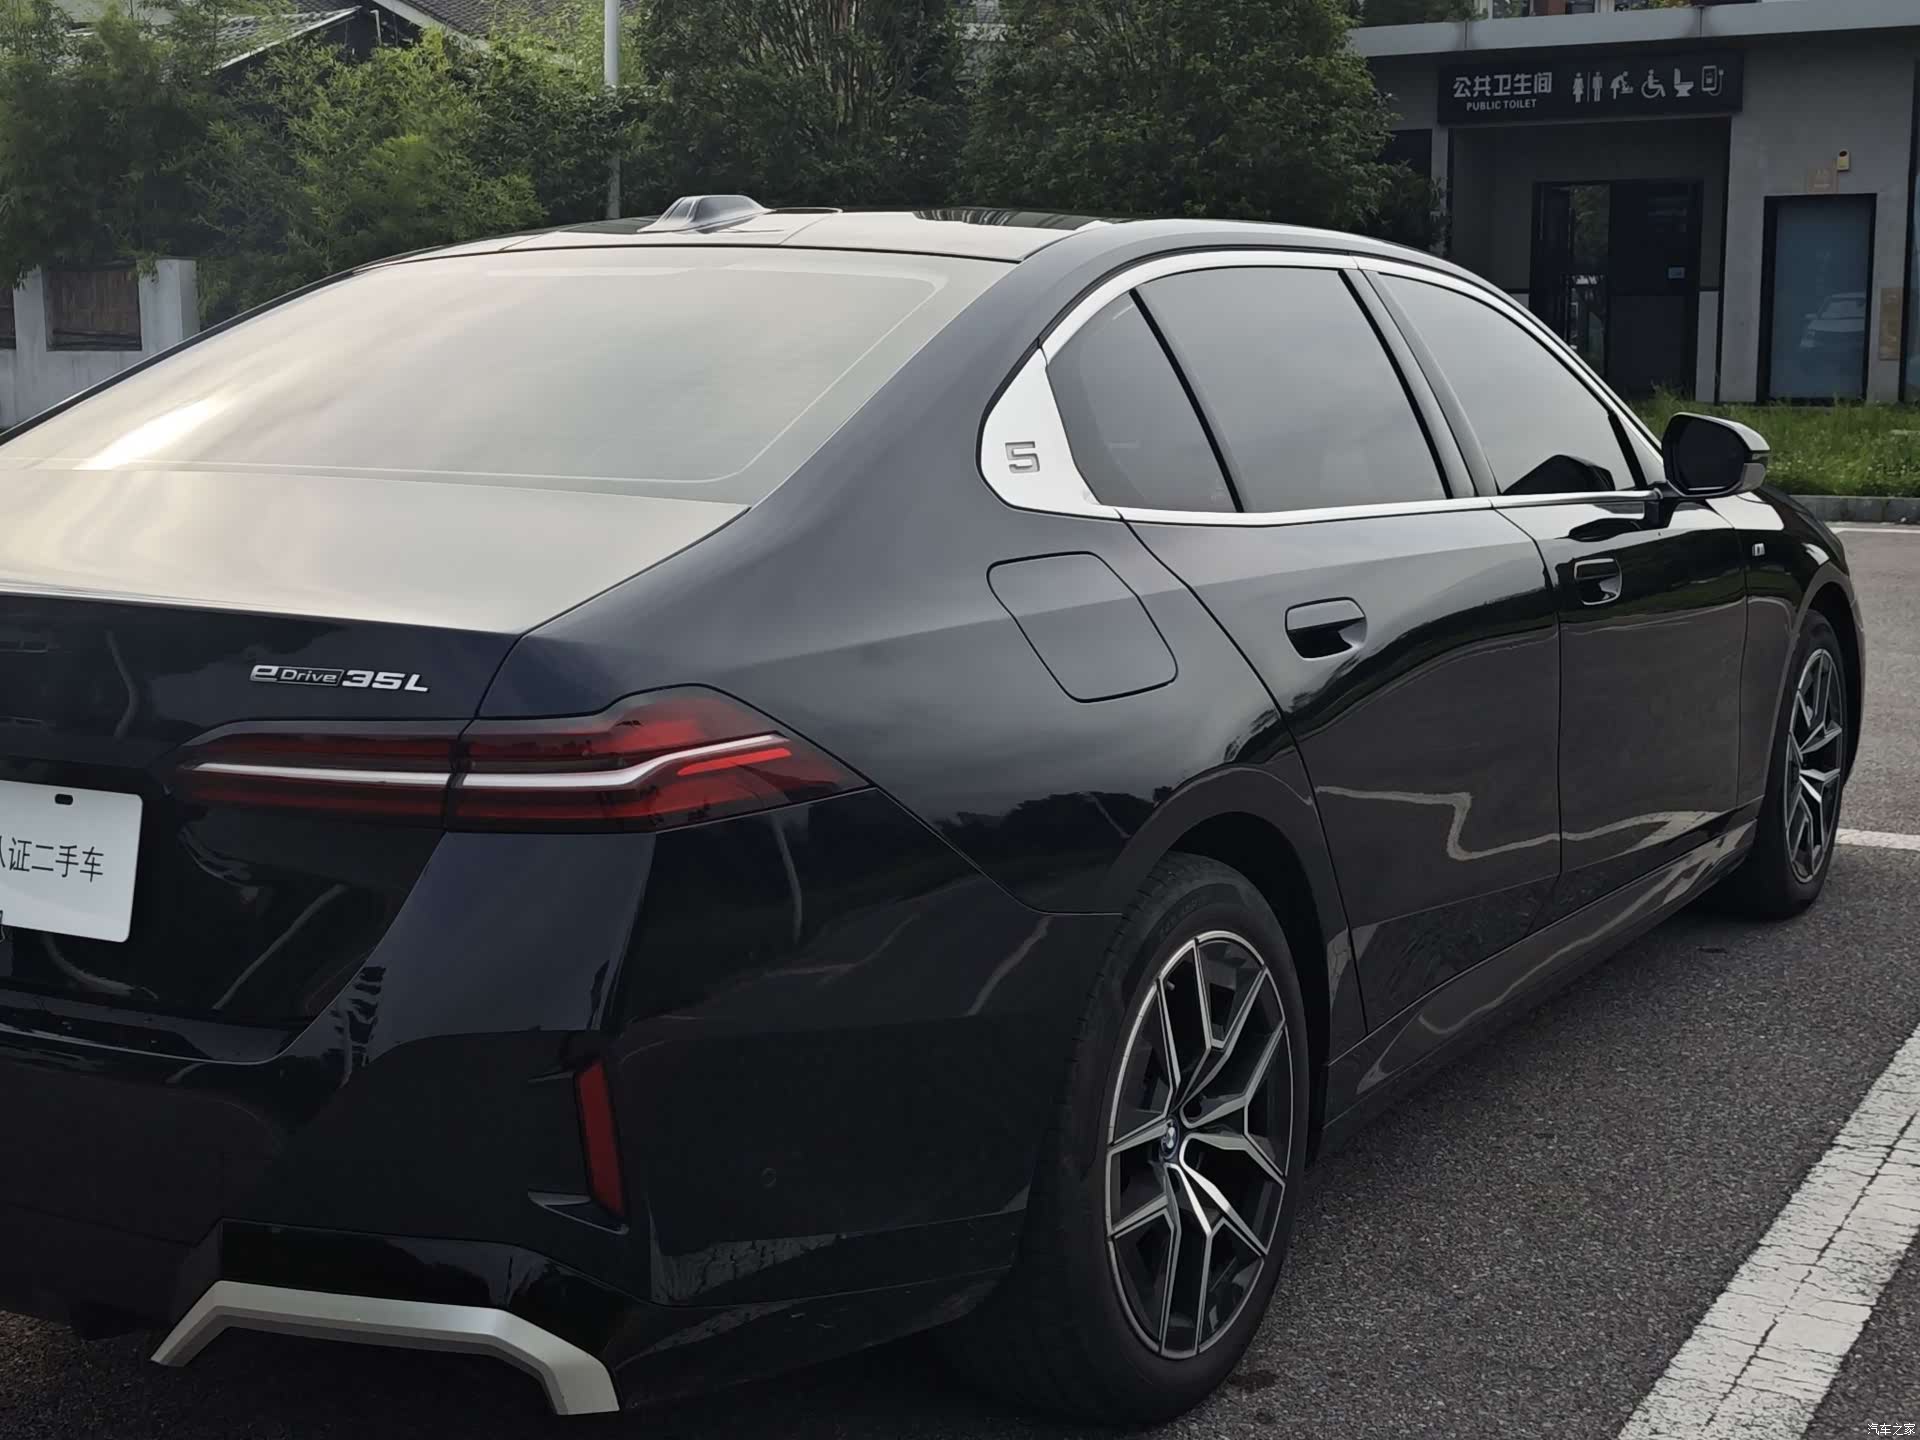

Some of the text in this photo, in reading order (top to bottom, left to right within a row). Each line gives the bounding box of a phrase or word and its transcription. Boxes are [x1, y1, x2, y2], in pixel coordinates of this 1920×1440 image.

[1452, 72, 1553, 98] 公共卫生间
[1466, 99, 1537, 111] PUBLIC TOILET
[1005, 441, 1040, 473] 5
